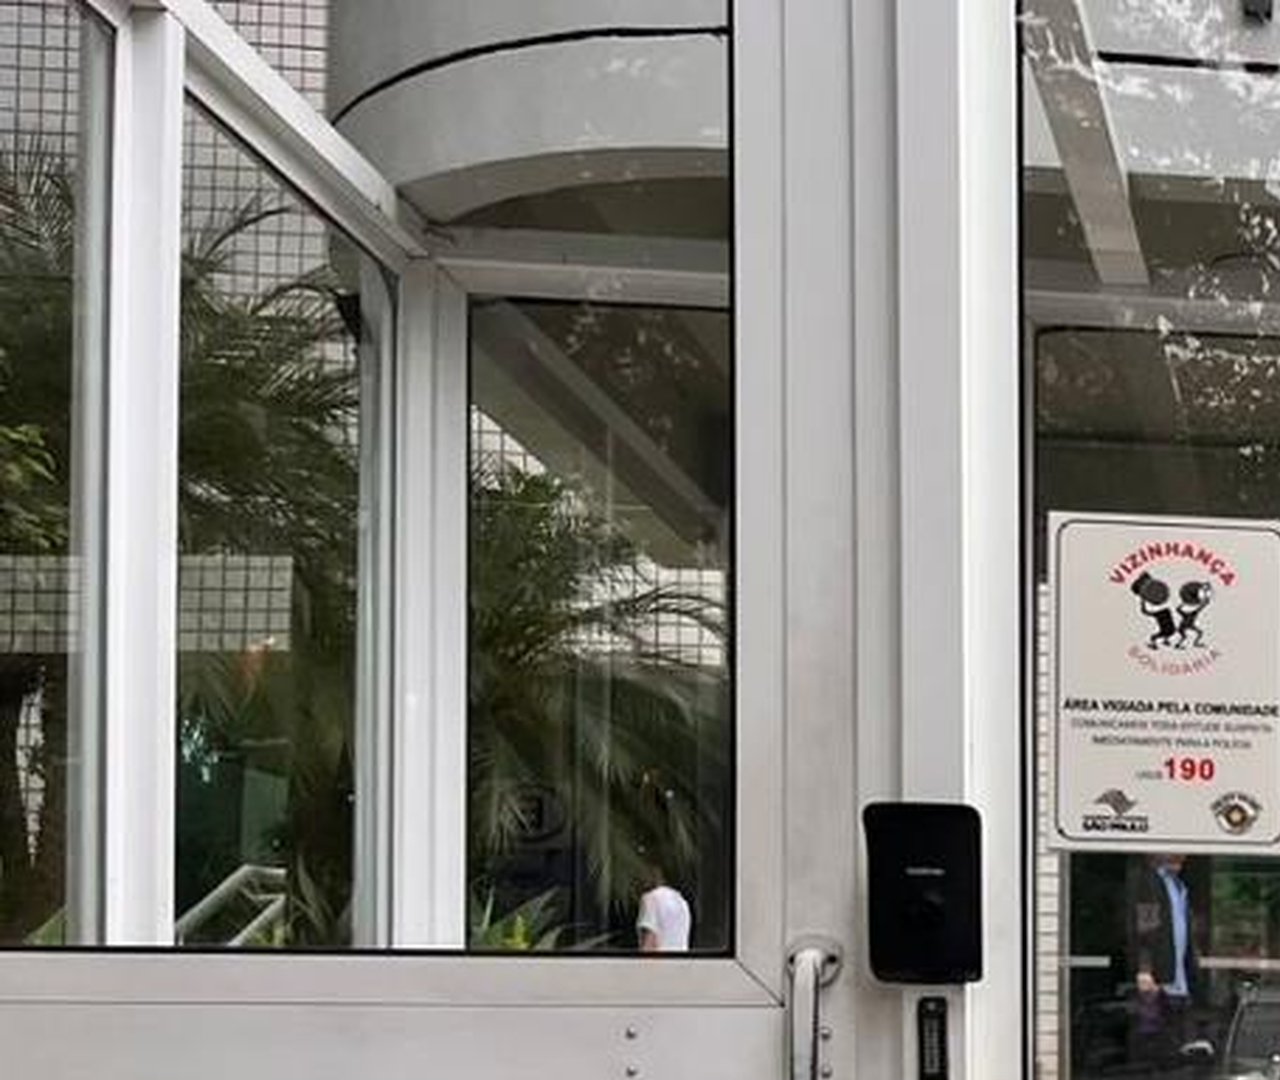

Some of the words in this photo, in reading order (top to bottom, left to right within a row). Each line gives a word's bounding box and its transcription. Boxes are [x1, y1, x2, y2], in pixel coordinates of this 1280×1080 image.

[1110, 542, 1235, 585] VIZINHANÇA
[1101, 701, 1154, 712] VIGIADA
[1158, 702, 1190, 714] PELA
[1194, 703, 1280, 717] COMUNIDADE
[1164, 757, 1215, 780] 190
